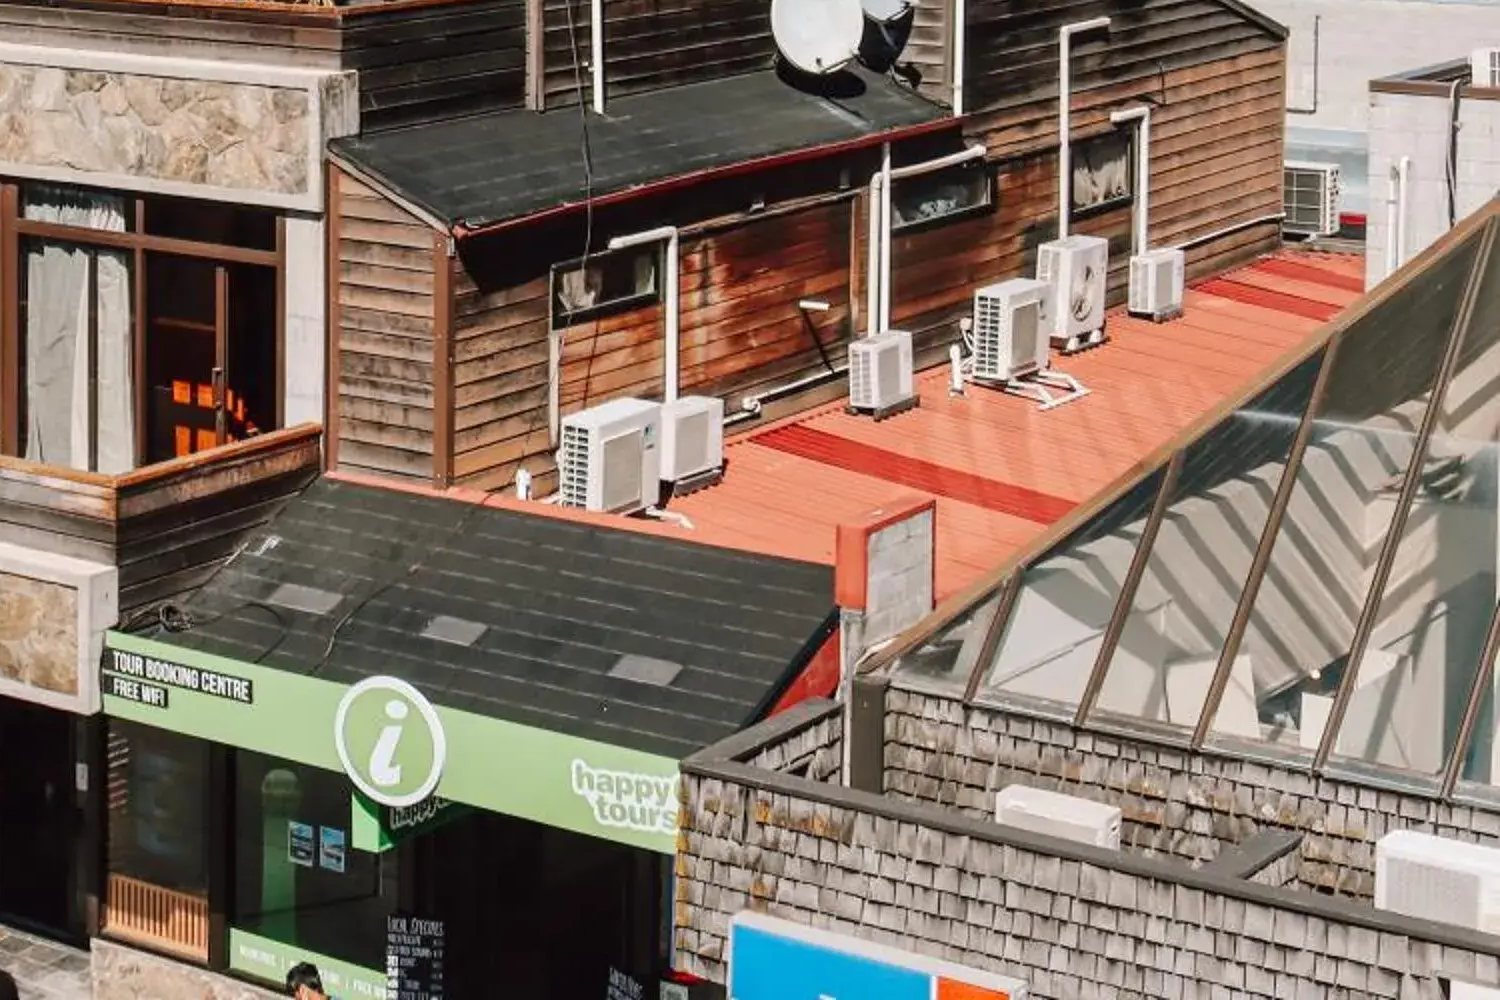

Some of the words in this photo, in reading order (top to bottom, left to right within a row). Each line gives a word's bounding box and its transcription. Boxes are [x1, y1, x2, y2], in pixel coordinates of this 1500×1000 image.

[113, 651, 144, 676] TOUR
[145, 658, 199, 688] BOOKING
[201, 671, 250, 701] CENTRE
[113, 677, 141, 700] FREE
[141, 684, 165, 707] WIFI
[574, 761, 671, 807] happy
[597, 794, 675, 828] tours
